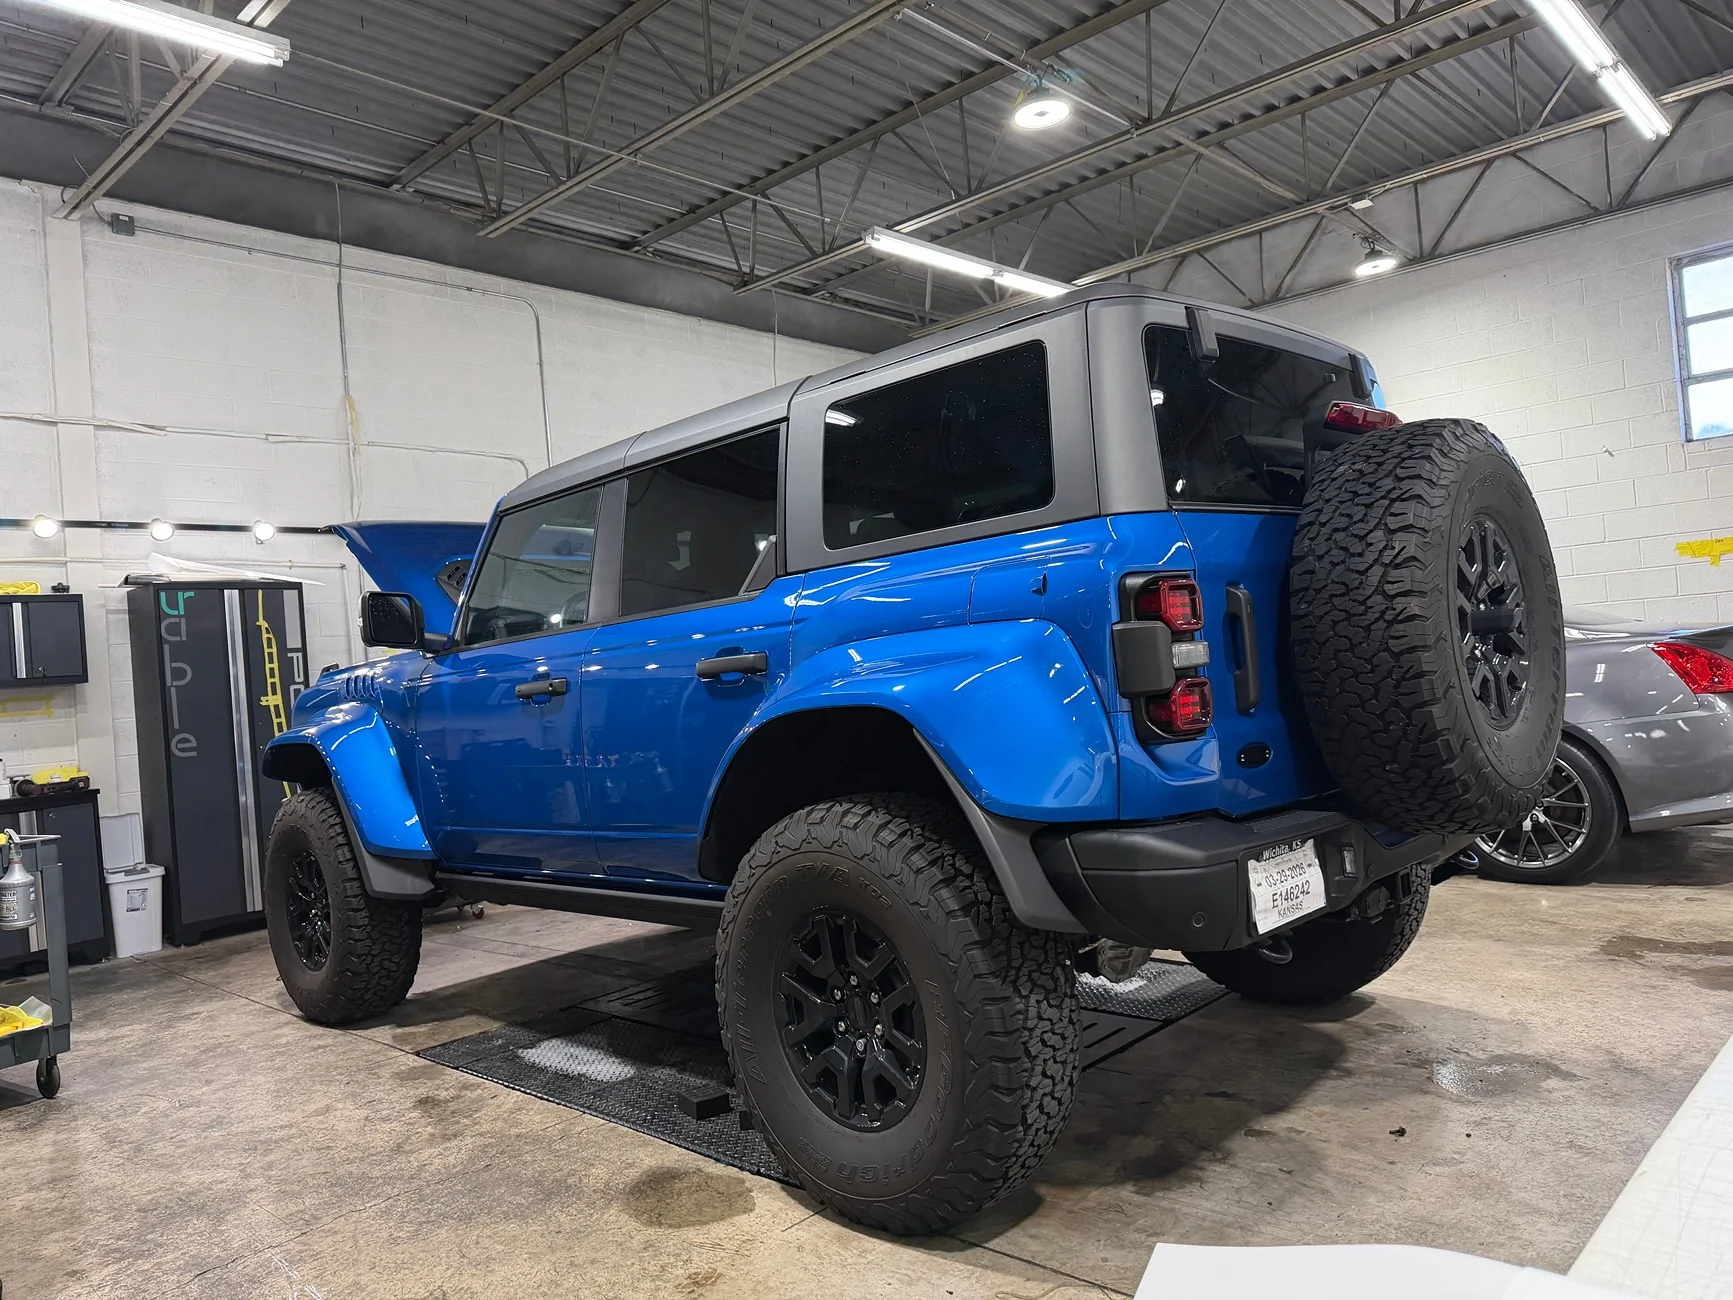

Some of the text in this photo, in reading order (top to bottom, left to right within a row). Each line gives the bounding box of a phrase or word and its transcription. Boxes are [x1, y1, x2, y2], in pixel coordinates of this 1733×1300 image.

[1292, 839, 1301, 850] KS
[796, 862, 850, 888] T/A
[1265, 862, 1307, 888] 03-29-2026
[1272, 879, 1311, 909] E146242
[1278, 900, 1303, 919] KANSAS
